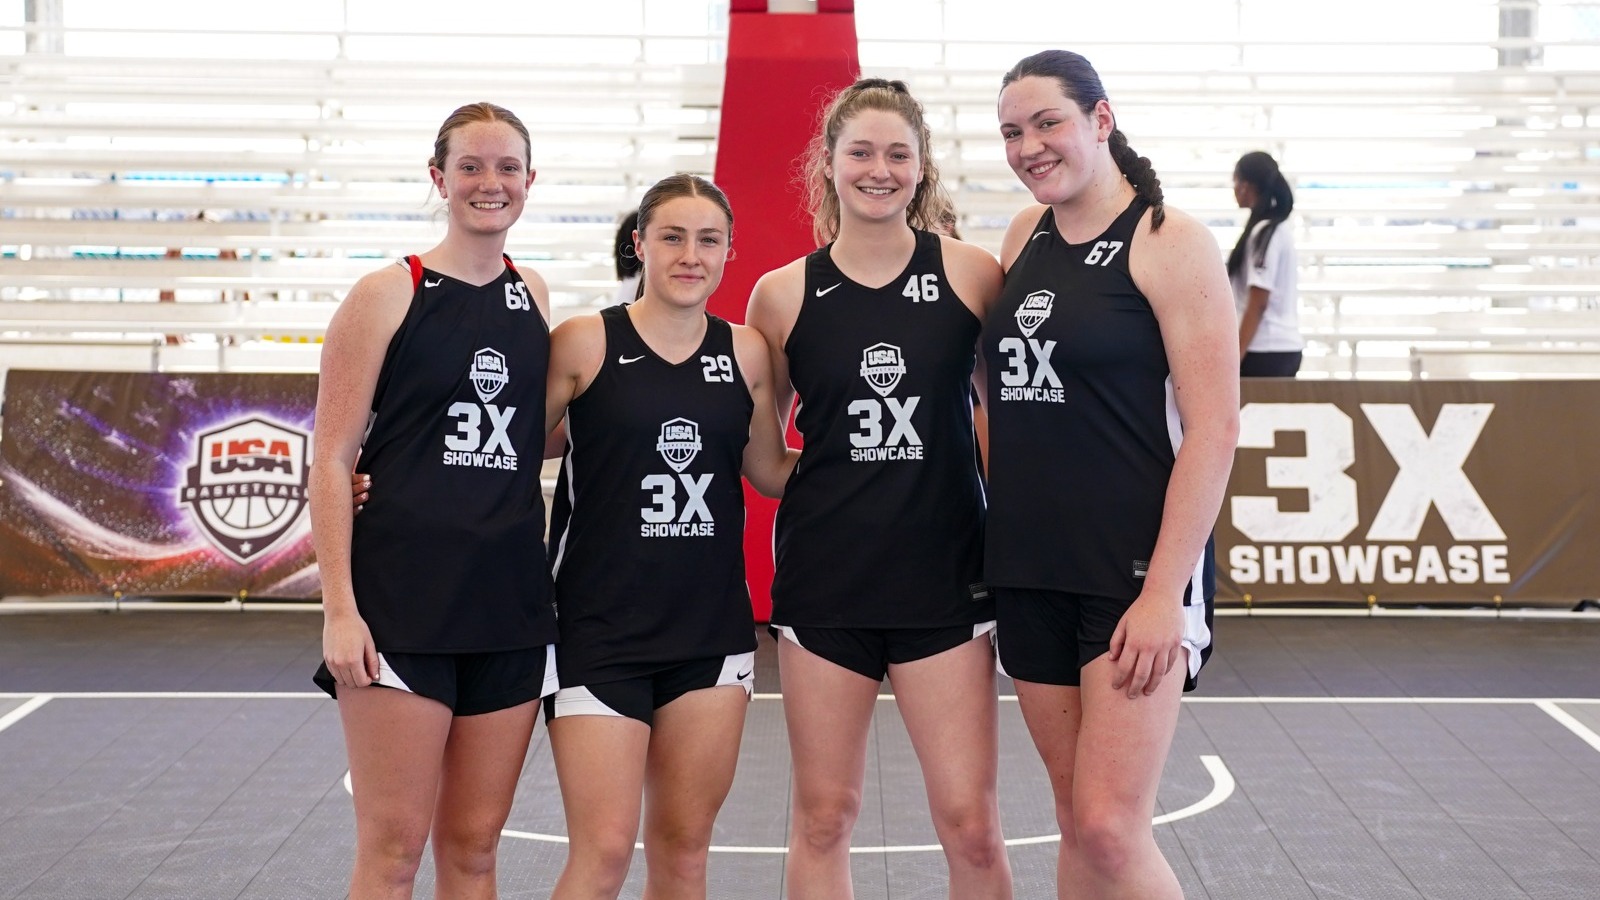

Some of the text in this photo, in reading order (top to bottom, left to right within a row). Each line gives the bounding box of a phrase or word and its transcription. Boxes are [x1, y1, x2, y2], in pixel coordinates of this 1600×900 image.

[1084, 241, 1123, 267] 67
[504, 281, 531, 312] 68
[902, 273, 939, 303] 46
[1025, 295, 1050, 309] USA
[477, 354, 503, 372] USA
[700, 354, 734, 383] 29
[867, 349, 897, 366] USA
[998, 337, 1064, 389] 3X
[1000, 387, 1065, 404] SHOWCASE
[444, 401, 518, 457] 3X
[665, 425, 694, 441] USA
[847, 396, 923, 448] 3X
[211, 438, 293, 475] USA
[443, 451, 518, 471] SHOWCASE
[851, 446, 924, 462] SHOWCASE
[1230, 402, 1508, 543] 3X
[641, 473, 715, 523] 3X
[640, 522, 715, 538] SHOWCASE
[1229, 545, 1511, 584] SHOWCASE
